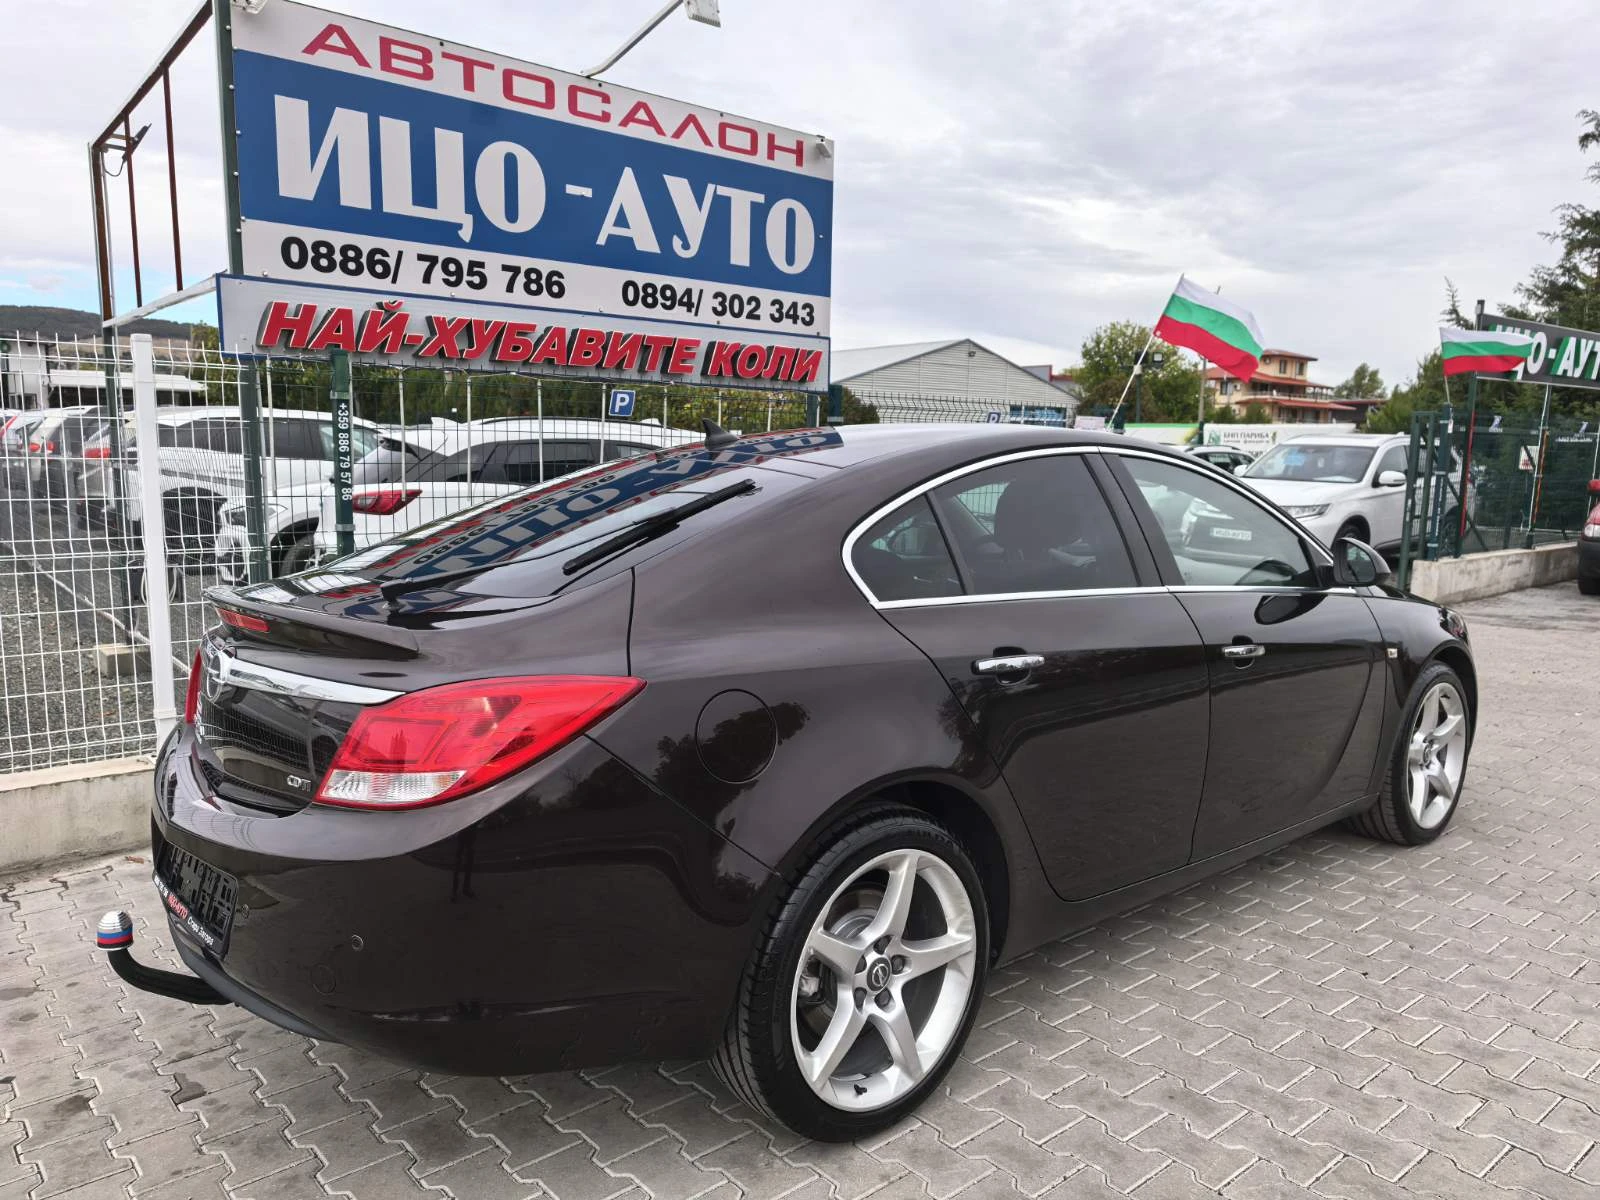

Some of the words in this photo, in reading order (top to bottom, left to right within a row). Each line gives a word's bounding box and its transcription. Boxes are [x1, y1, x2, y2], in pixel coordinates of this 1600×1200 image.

[302, 23, 804, 168] АВТОСАЛОН
[274, 94, 546, 243] ИЦО
[281, 237, 403, 284] 0886/
[417, 253, 488, 291] 795
[502, 264, 566, 299] 786
[622, 280, 703, 317] 0894/
[712, 291, 761, 321] 302
[769, 298, 815, 327] 343
[258, 301, 702, 375] НАЙ-ХУБАВИТЕ
[708, 341, 823, 382] КОЛИ
[337, 402, 349, 430] +359
[338, 432, 350, 454] 886
[339, 455, 351, 469] 79
[340, 471, 352, 485] 57
[341, 487, 353, 501] 86
